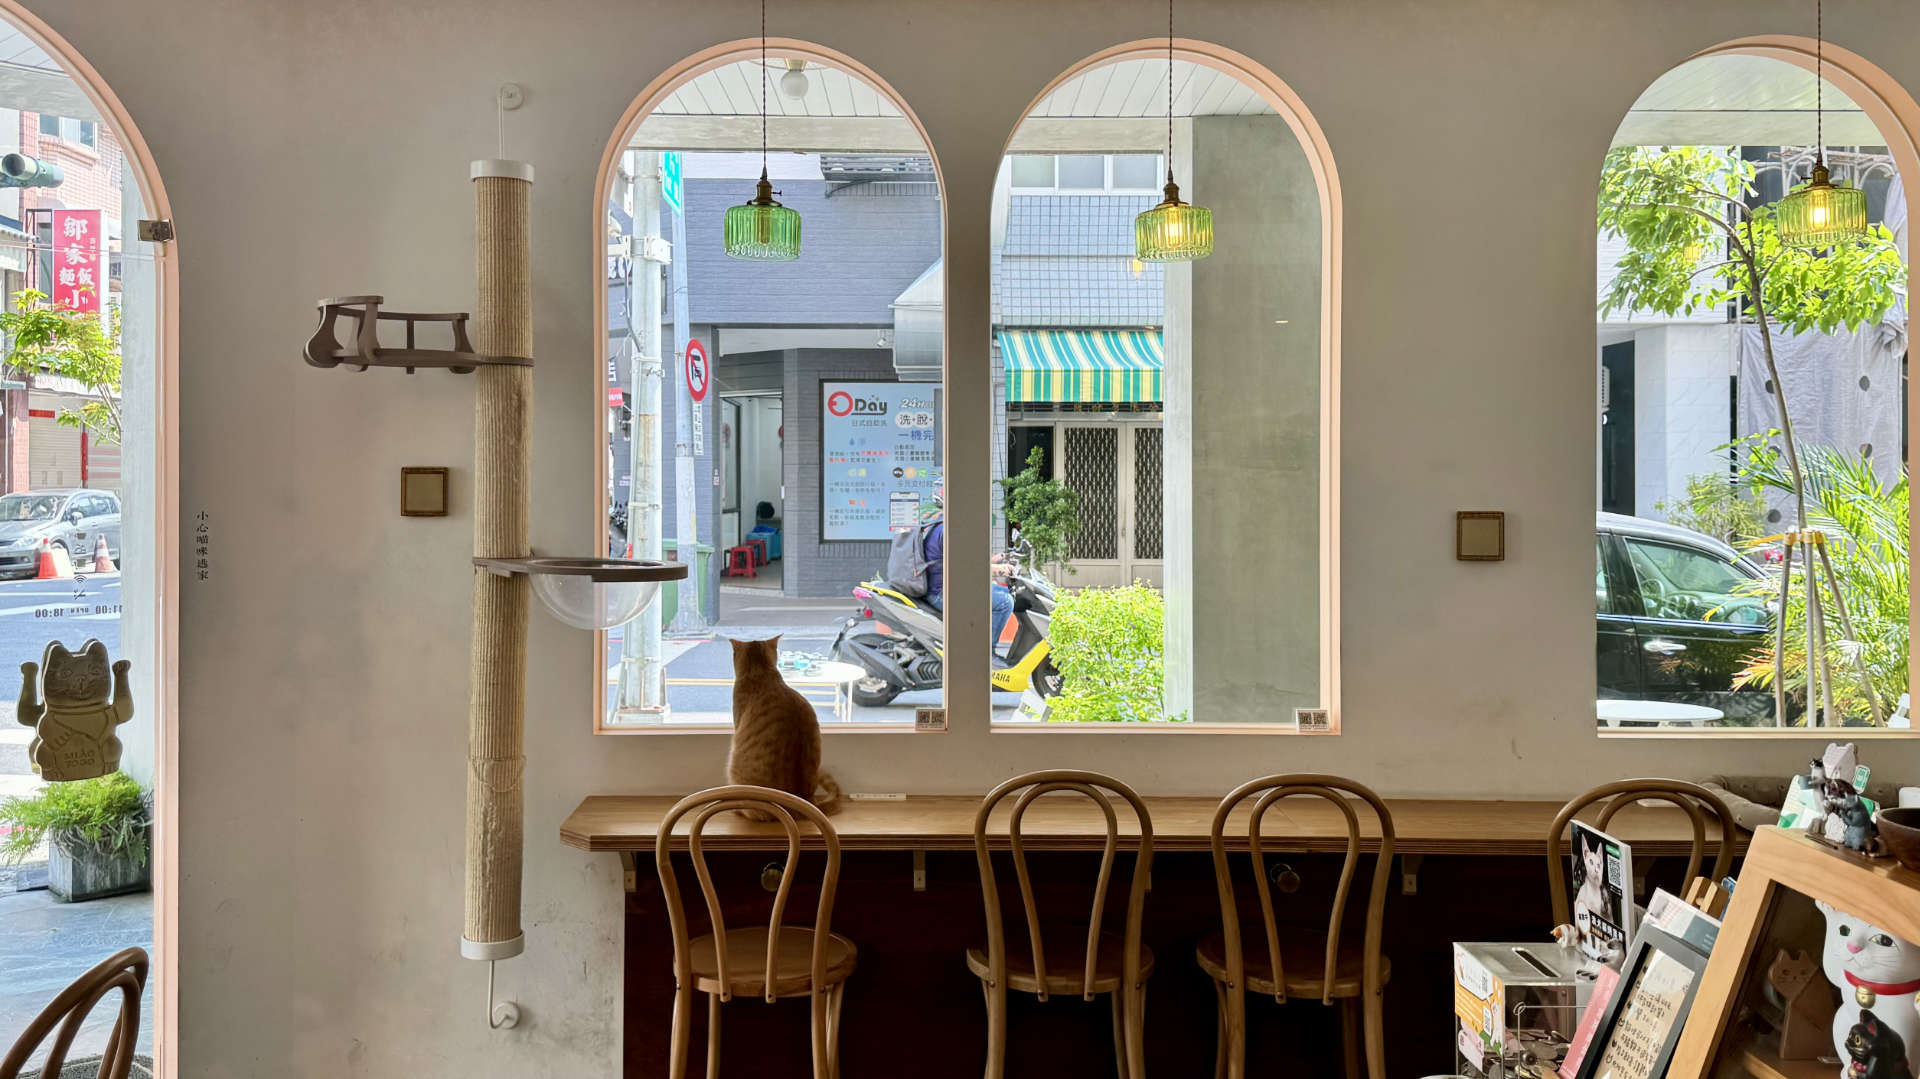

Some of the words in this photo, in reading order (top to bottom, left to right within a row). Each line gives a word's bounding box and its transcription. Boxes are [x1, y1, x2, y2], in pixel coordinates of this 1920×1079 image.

[196, 511, 209, 581] 小心喵咪逃家
